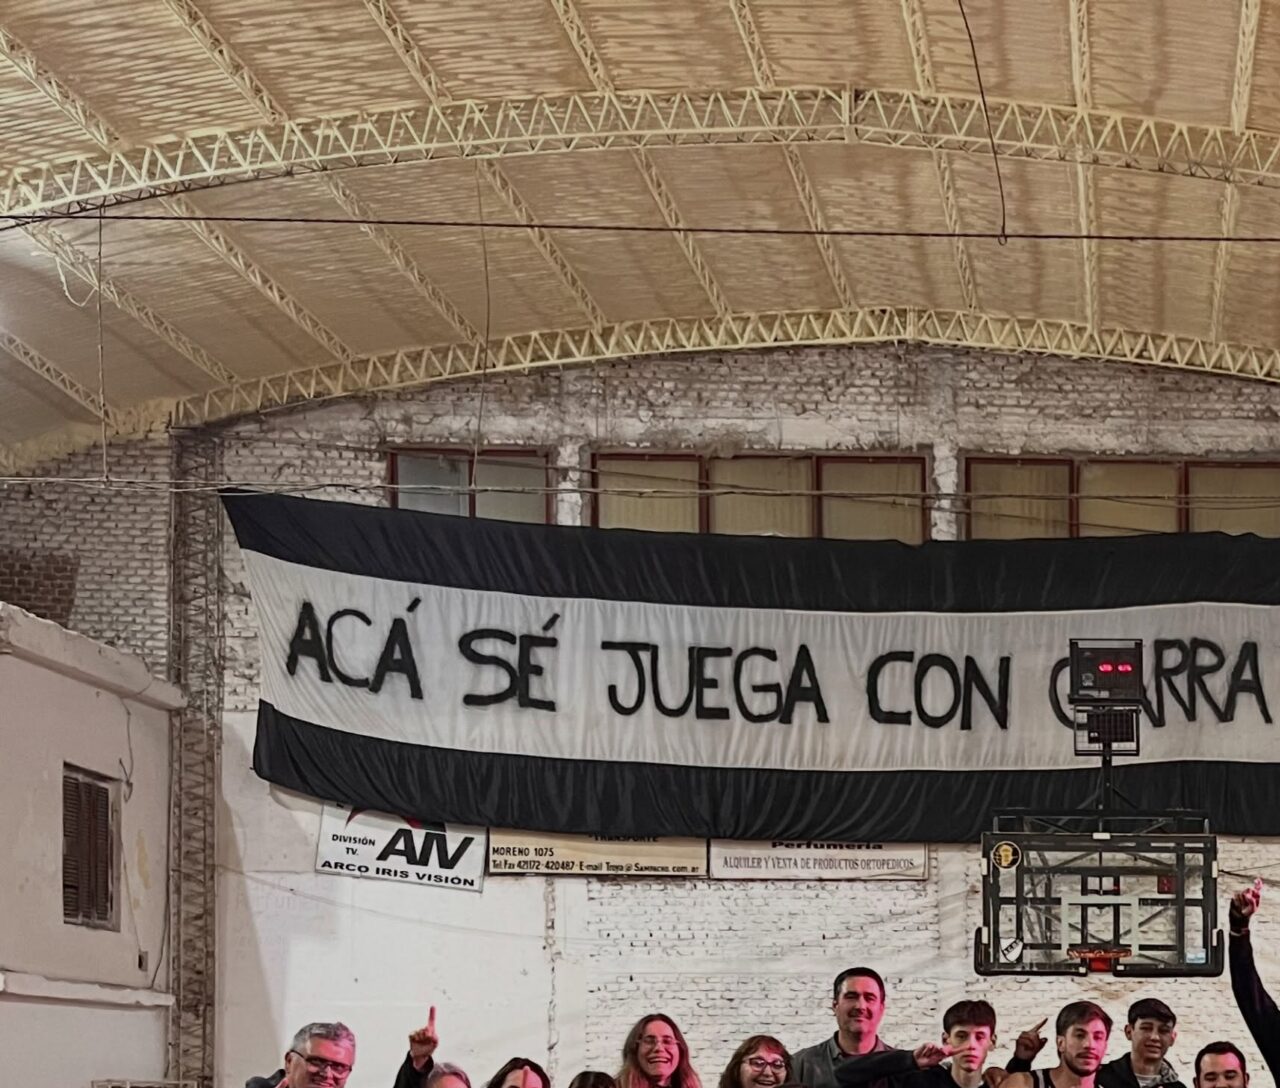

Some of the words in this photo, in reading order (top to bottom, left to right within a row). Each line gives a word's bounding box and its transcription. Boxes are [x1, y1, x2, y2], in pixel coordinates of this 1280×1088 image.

[286, 597, 423, 700] ACÁ
[458, 612, 561, 713] SÉ
[600, 641, 829, 725] JUEGA
[866, 648, 1011, 731] CON
[332, 834, 376, 847] DIVISIÓN
[492, 847, 530, 856] MORENO
[534, 848, 554, 857] 1075
[722, 856, 762, 869] ALQUILER
[764, 856, 770, 868] Y
[772, 856, 799, 869] VENTA
[801, 857, 811, 869] DE
[813, 857, 859, 870] PRODUCTOS
[861, 858, 914, 869] ORTOPEDICOS
[321, 860, 369, 874] ARCO
[376, 867, 409, 879] IRIS
[416, 872, 475, 887] VISIÓN
